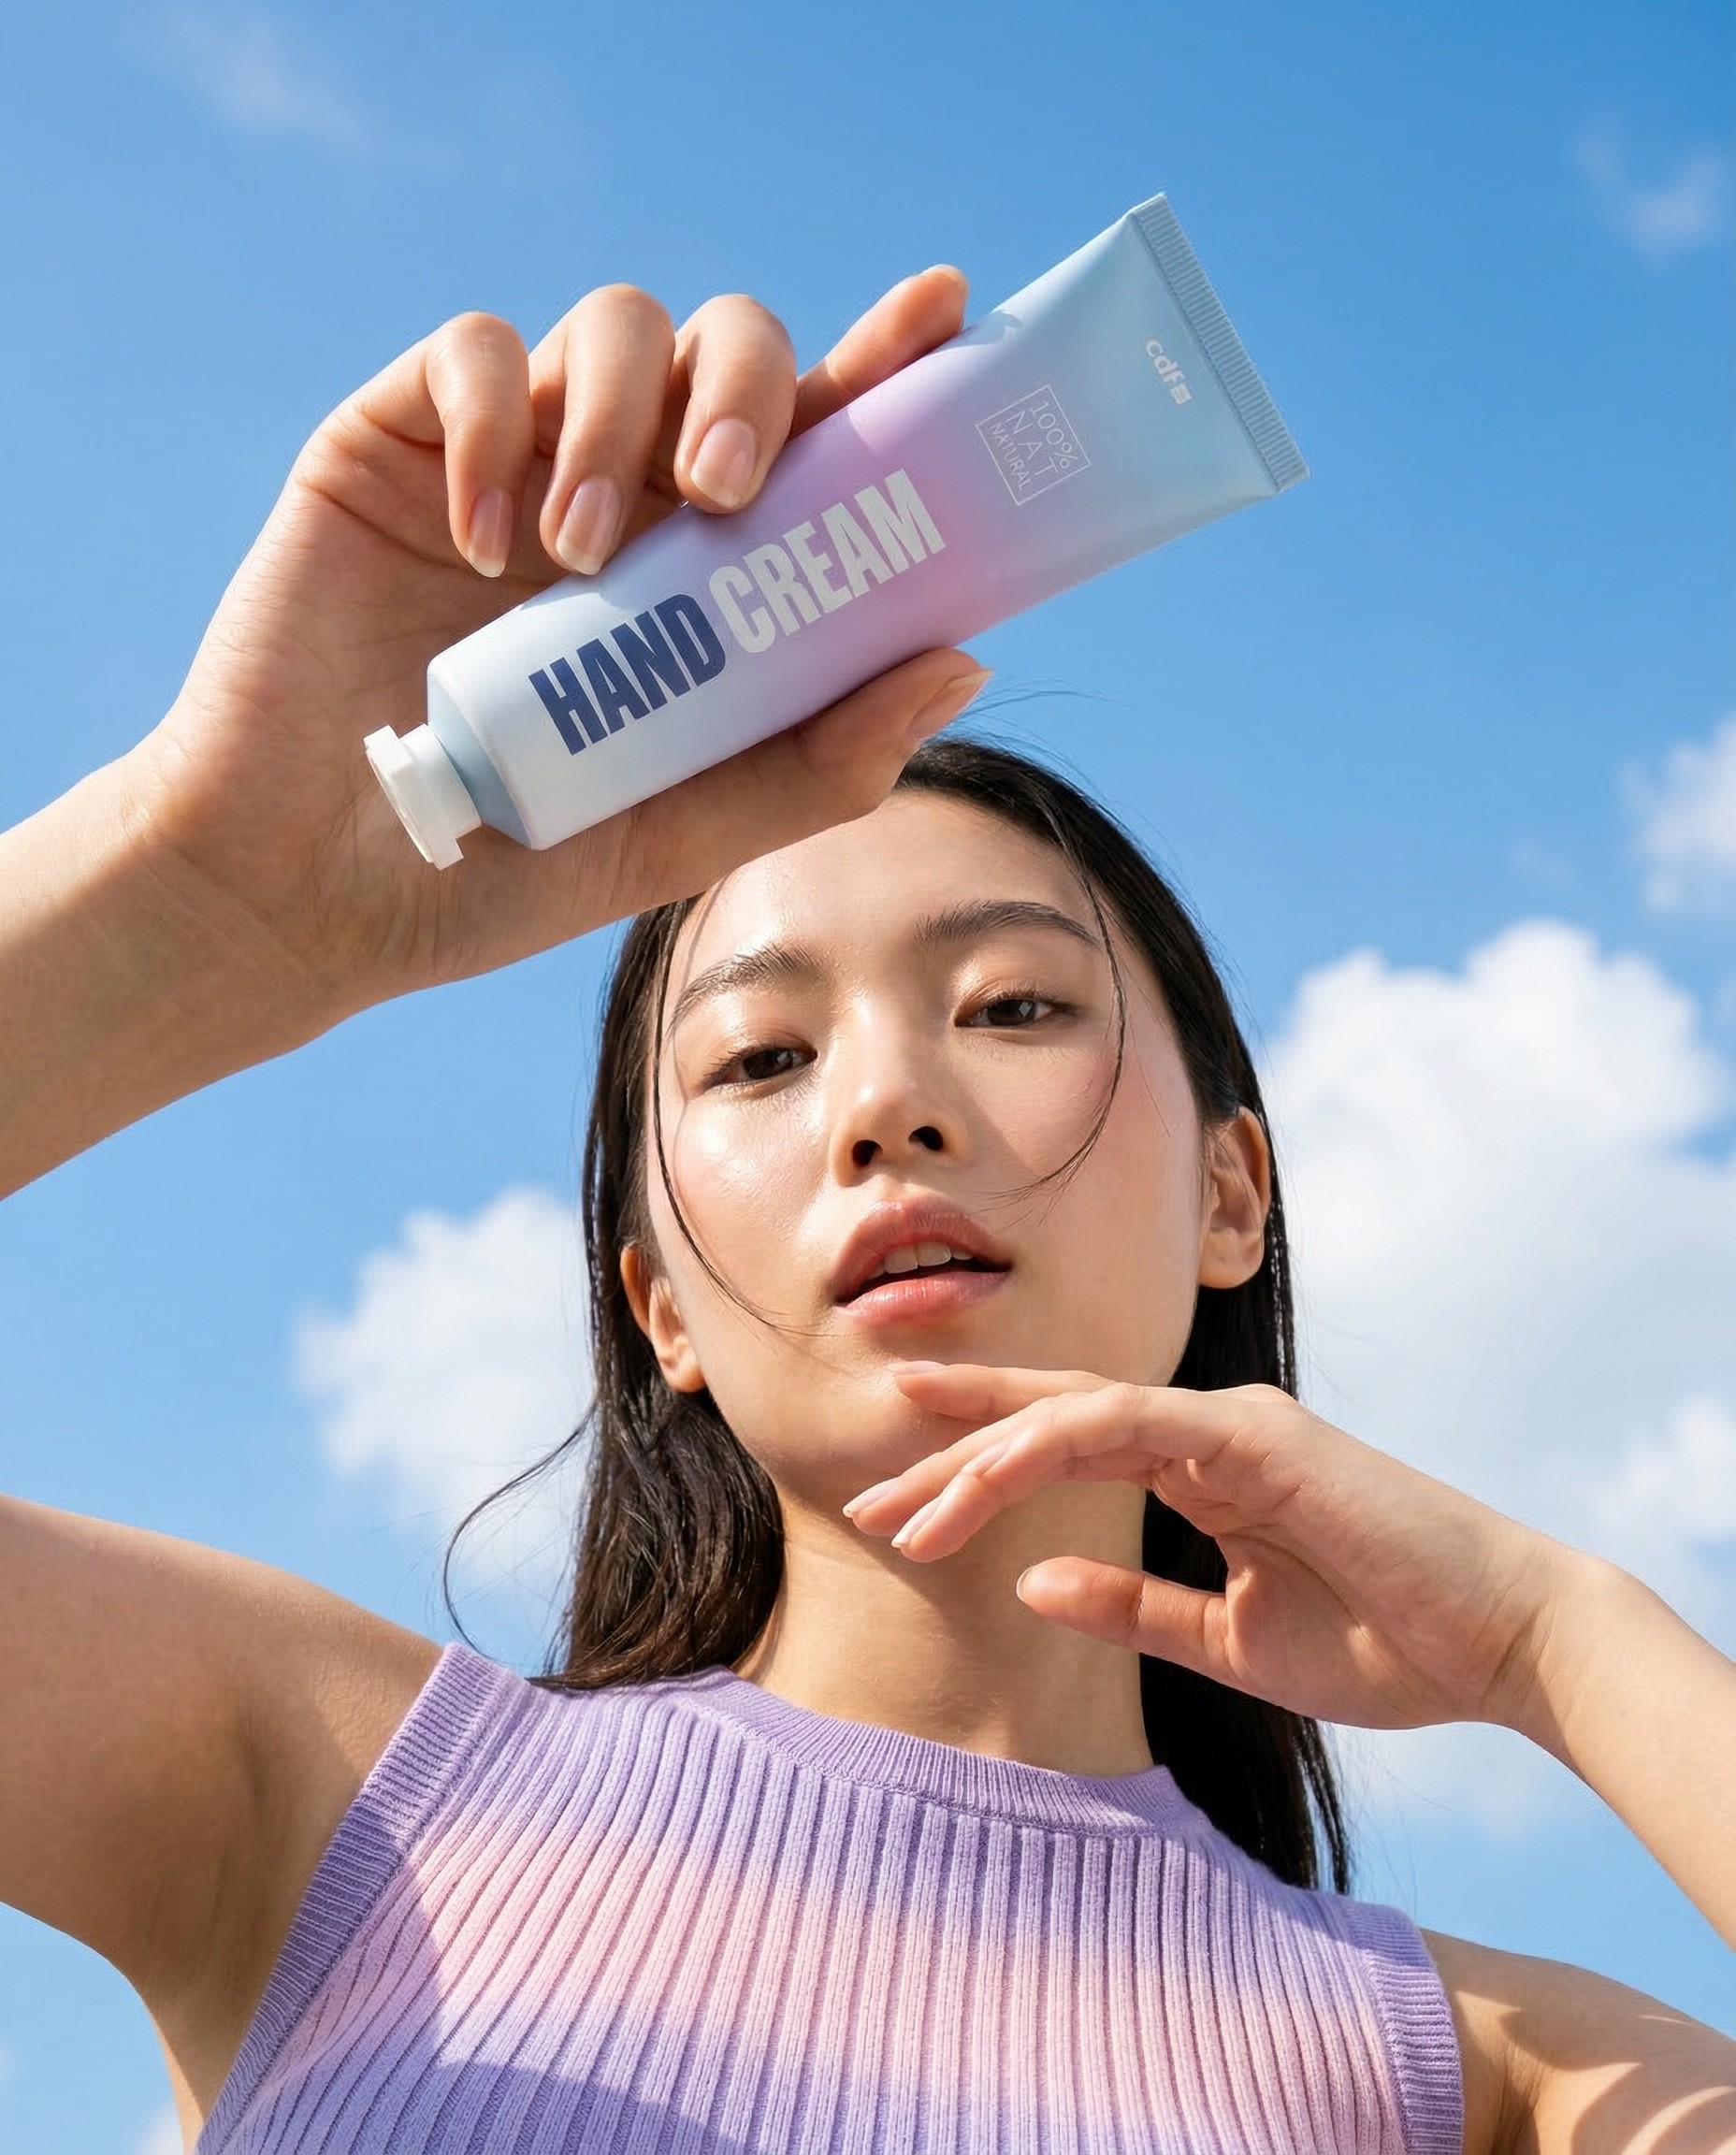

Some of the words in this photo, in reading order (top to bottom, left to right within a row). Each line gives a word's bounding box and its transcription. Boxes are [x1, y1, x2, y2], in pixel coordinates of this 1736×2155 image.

[989, 422, 1032, 491] NATURAL
[1005, 410, 1059, 476] NAT
[1029, 399, 1078, 470] 100%
[528, 593, 727, 756] HAND
[708, 468, 947, 655] CREAM
